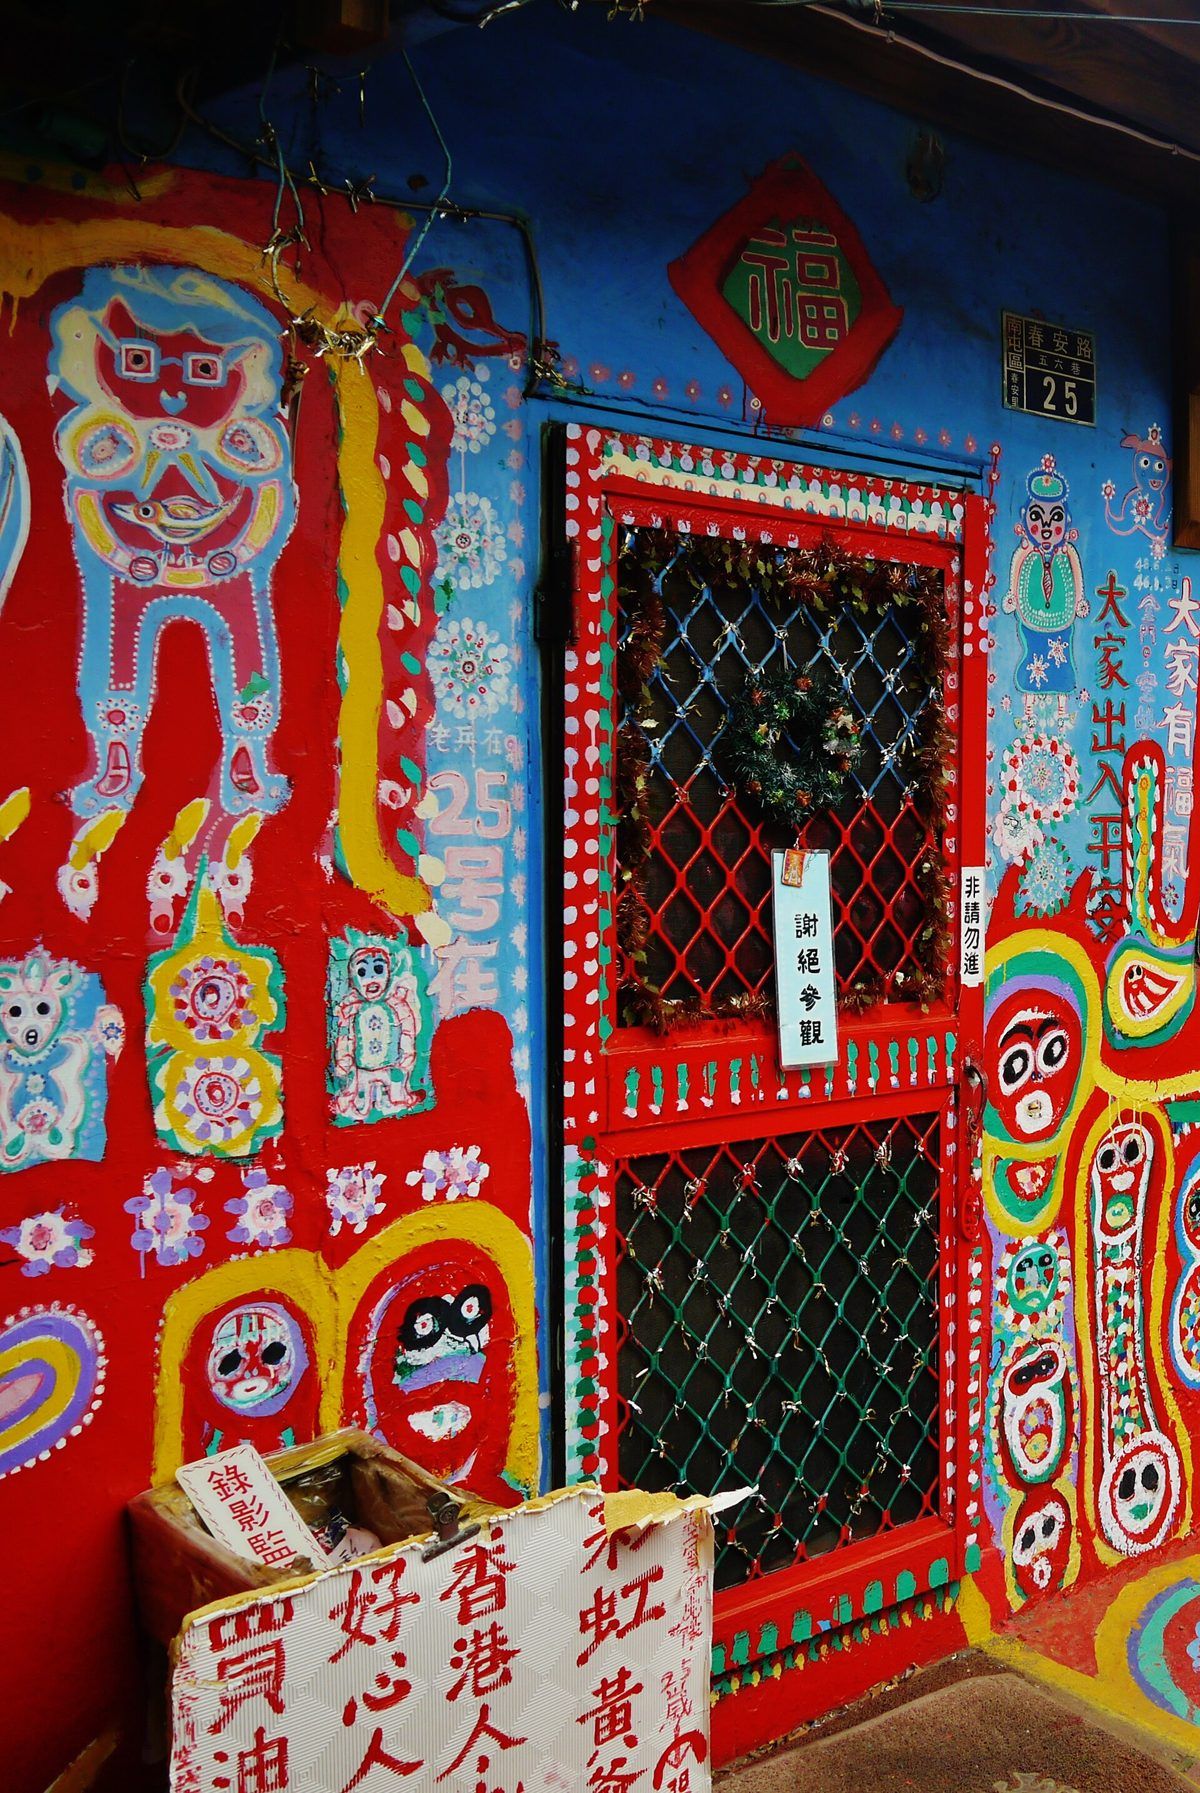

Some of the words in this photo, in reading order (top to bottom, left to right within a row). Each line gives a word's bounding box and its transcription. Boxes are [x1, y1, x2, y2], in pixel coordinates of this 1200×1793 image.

[741, 227, 848, 350] 福
[1008, 319, 1023, 370] 南屯區
[1011, 372, 1020, 407] 春安里
[1028, 325, 1092, 369] 春安路
[1039, 364, 1081, 385] 五六巷
[1043, 376, 1077, 415] 25
[963, 875, 981, 976] 非請勿進
[794, 913, 825, 1047] 謝絕參觀
[207, 1464, 298, 1568] 錄影監
[327, 1560, 425, 1793] 好心人
[432, 1526, 529, 1793] 香港人
